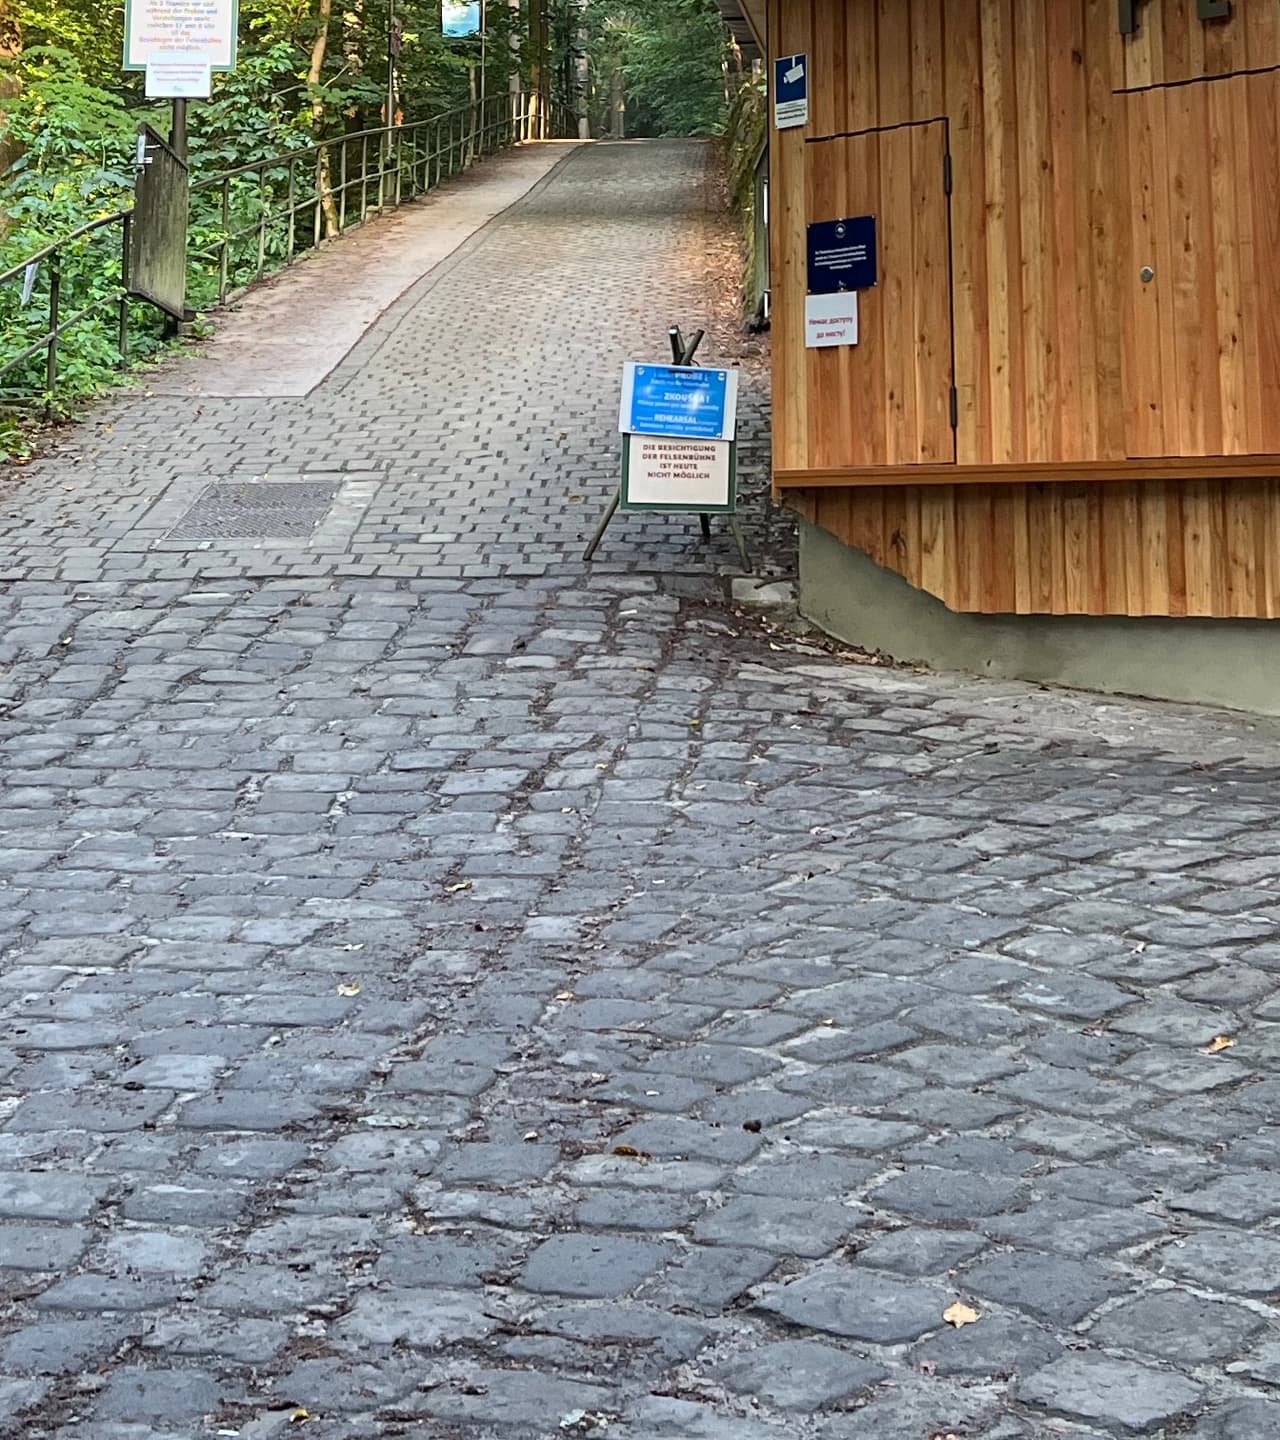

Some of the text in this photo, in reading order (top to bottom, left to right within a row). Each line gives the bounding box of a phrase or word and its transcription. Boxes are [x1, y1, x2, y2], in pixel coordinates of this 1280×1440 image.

[658, 444, 716, 452] BESICHTIGUNG
[660, 453, 716, 461] FELSENBÜHNE
[673, 471, 710, 479] MÖGLICH
